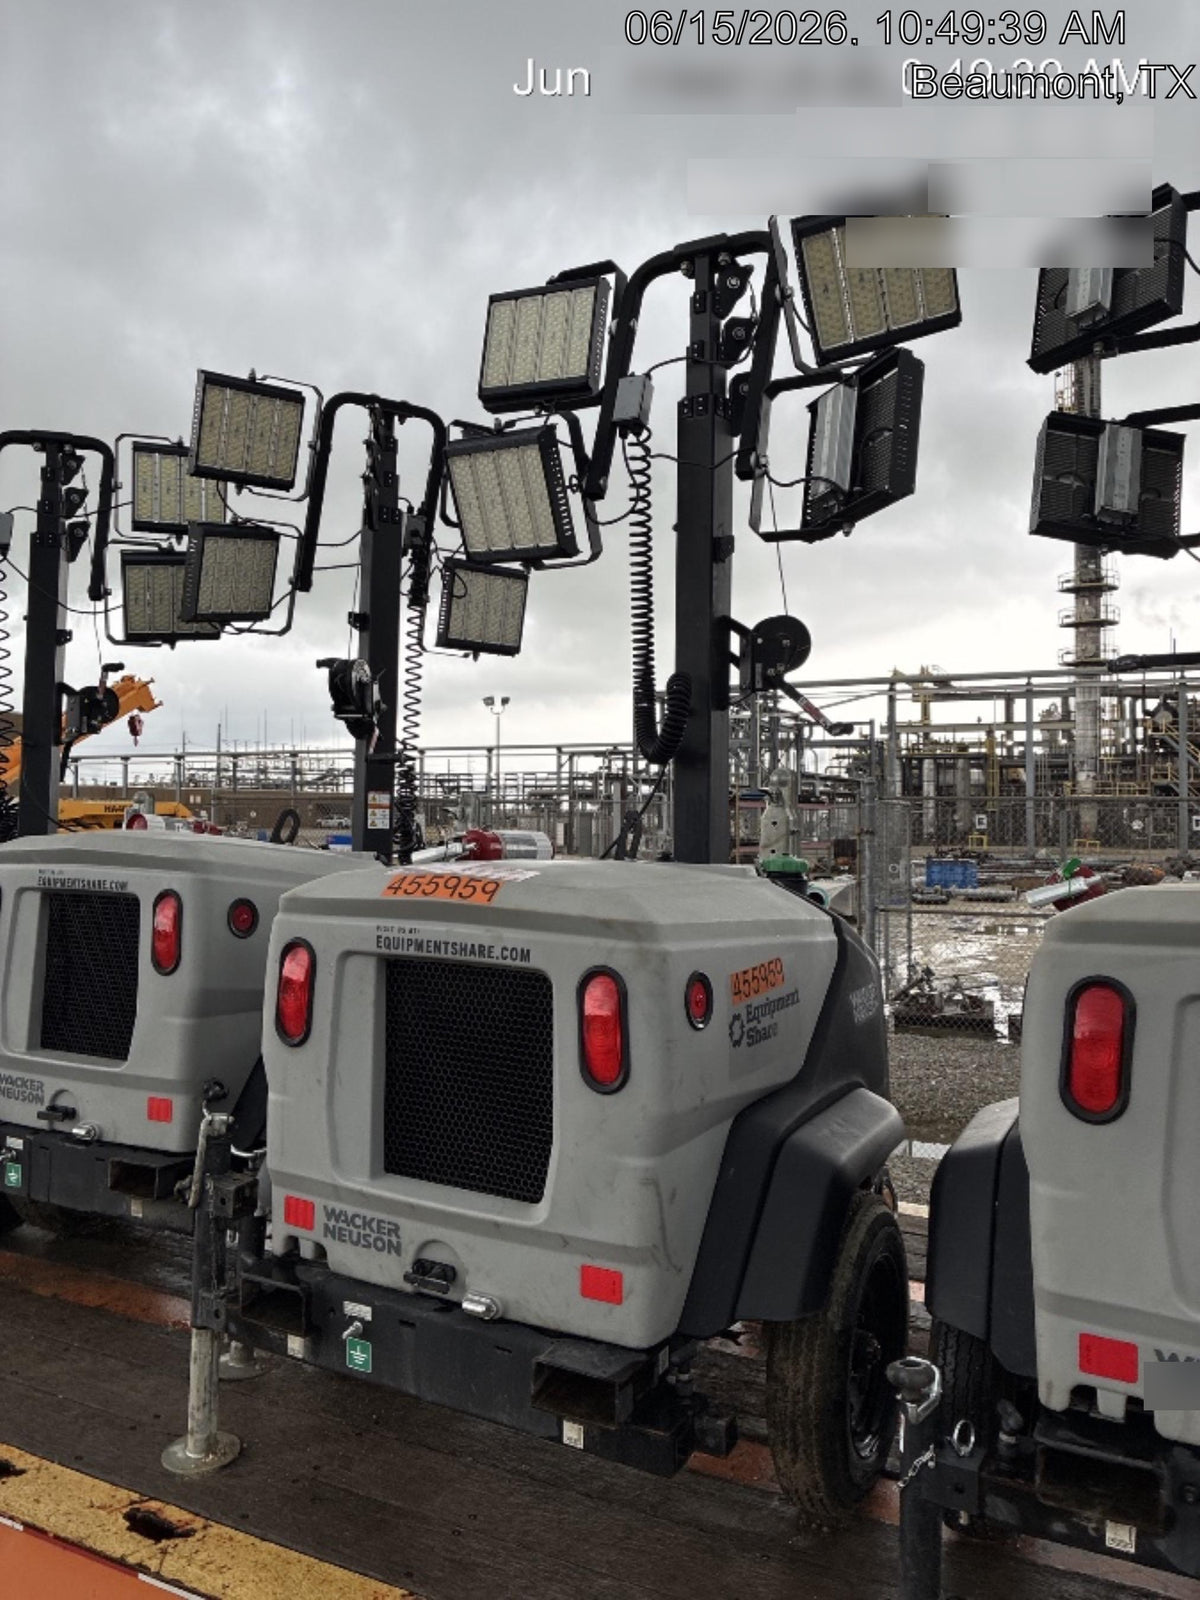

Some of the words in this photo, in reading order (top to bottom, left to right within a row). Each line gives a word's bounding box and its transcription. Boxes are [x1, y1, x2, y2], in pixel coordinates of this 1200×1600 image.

[387, 875, 500, 903] 455959
[376, 934, 531, 963] EQUIPMENTSHARE.COM
[732, 957, 785, 1000] 455959
[746, 989, 800, 1024] Equipment
[746, 1021, 778, 1047] Share
[323, 1205, 401, 1240] WACKER
[323, 1222, 402, 1257] NEUSON
